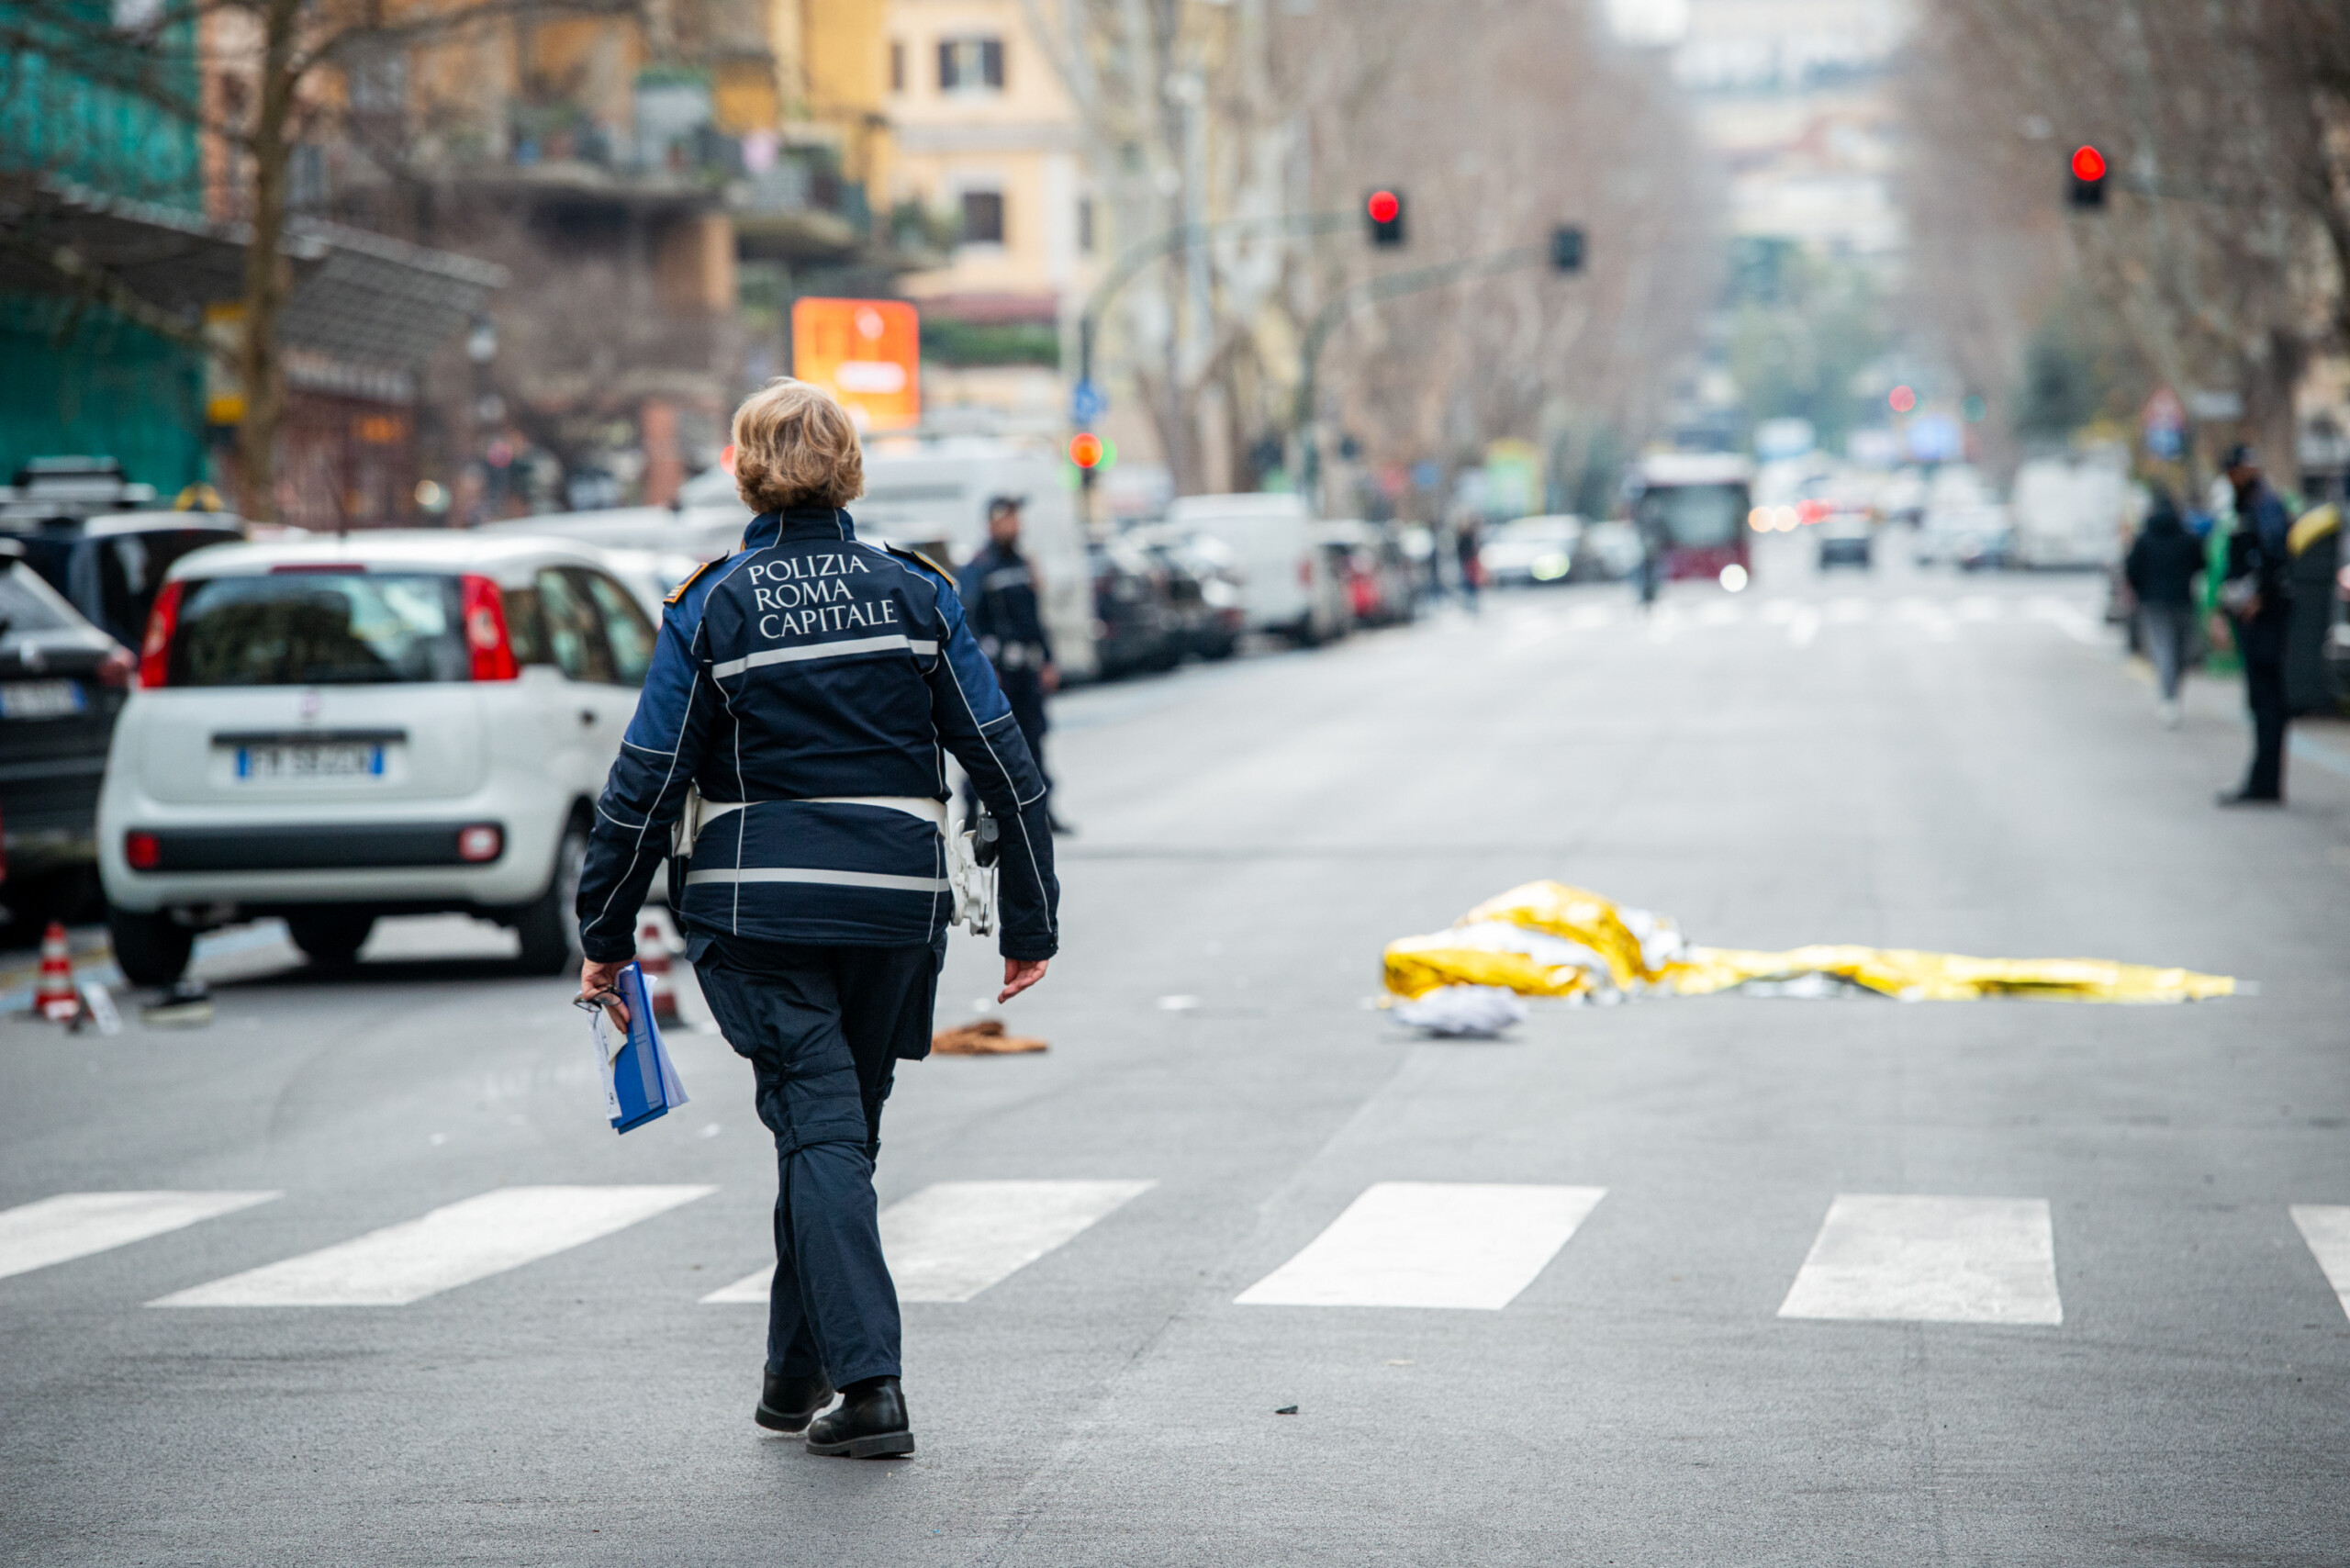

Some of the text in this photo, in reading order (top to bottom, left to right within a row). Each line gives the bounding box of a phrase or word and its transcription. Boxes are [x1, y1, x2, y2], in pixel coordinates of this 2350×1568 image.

[748, 554, 870, 585] POLIZIA
[754, 578, 854, 611] ROMA
[759, 599, 898, 639] CAPITALE
